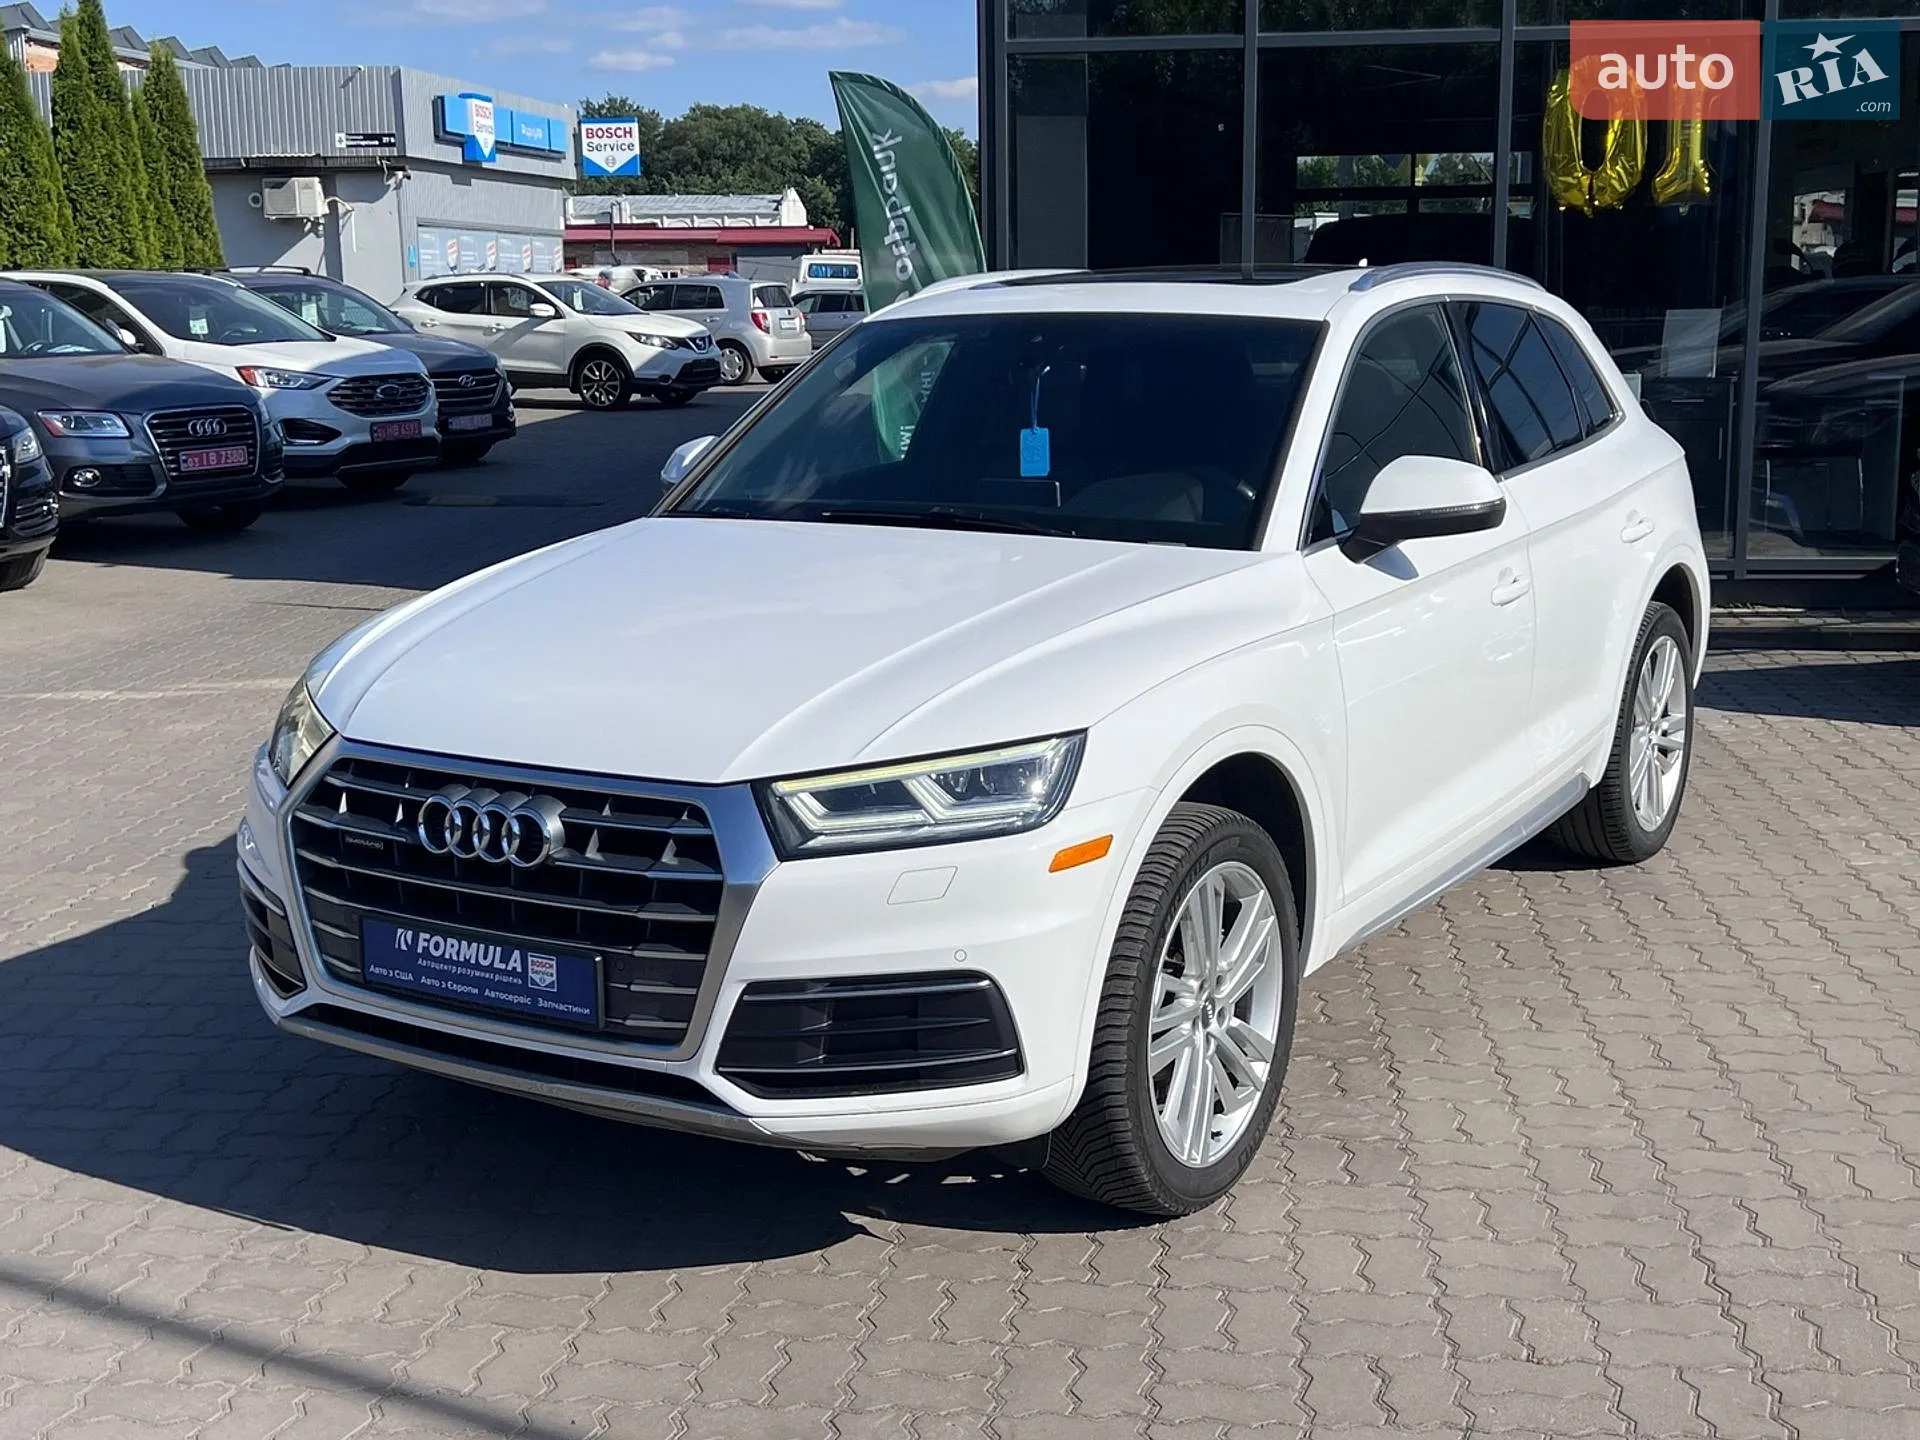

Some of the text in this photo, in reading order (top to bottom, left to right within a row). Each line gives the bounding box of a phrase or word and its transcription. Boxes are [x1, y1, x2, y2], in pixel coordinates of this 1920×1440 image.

[585, 127, 633, 139] BOSCH
[586, 141, 635, 152] Service
[417, 931, 523, 972] FORMULA
[369, 964, 388, 976] Авто
[394, 969, 414, 981] США
[420, 976, 440, 987] Авто
[447, 981, 479, 995] Європи
[484, 988, 532, 1005] Автосервіс
[537, 997, 591, 1015] Запчастини
